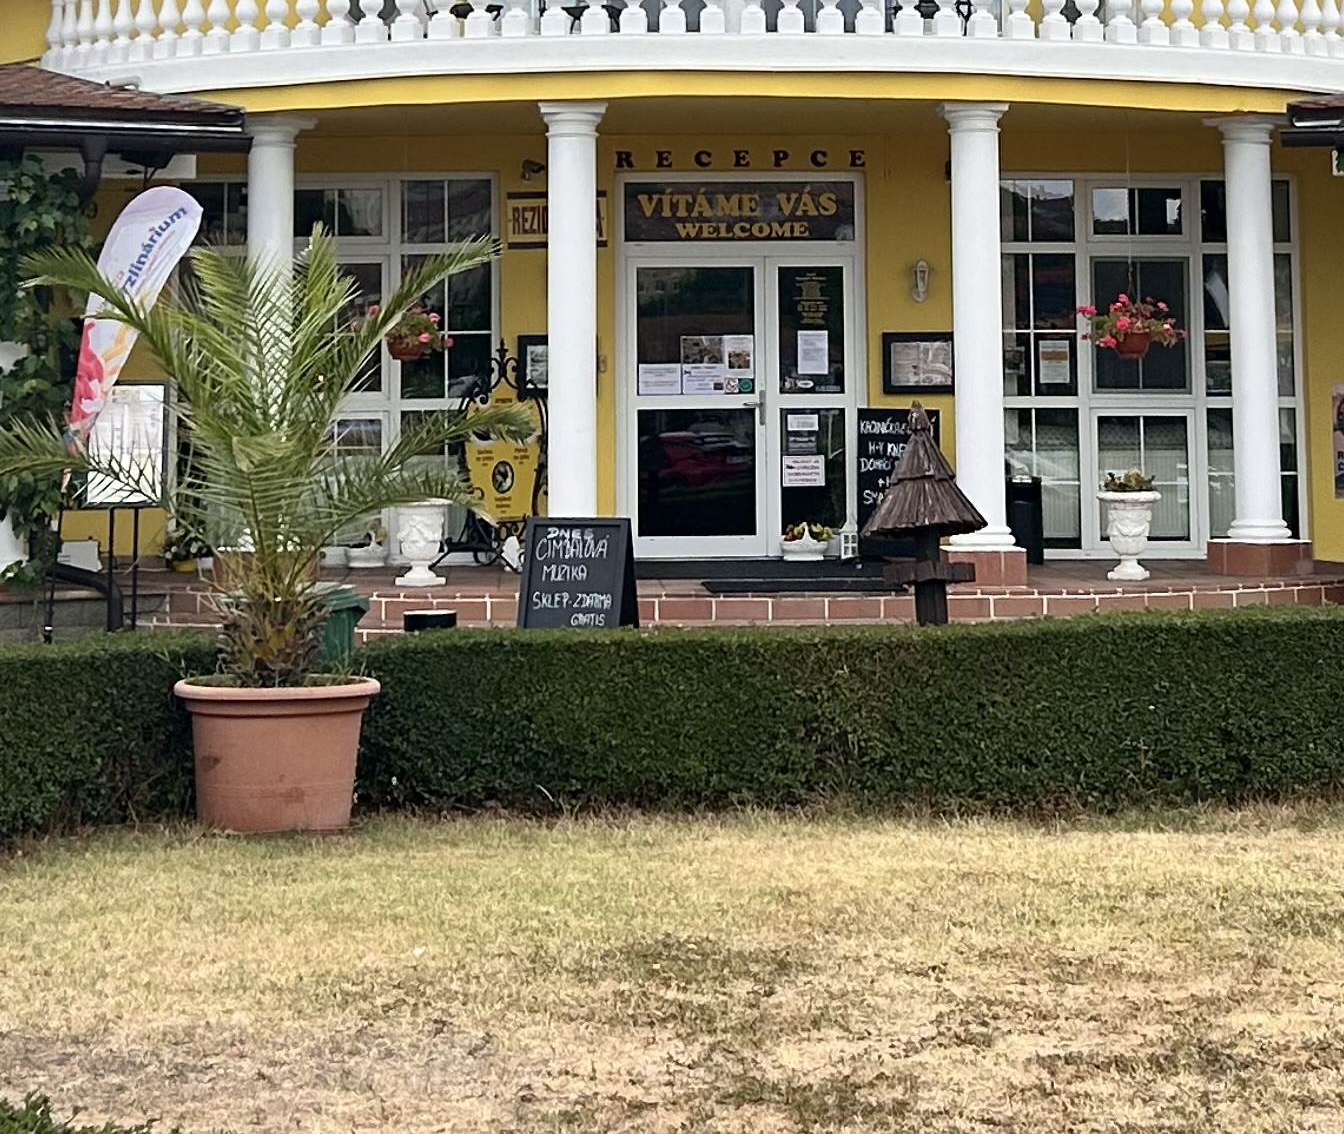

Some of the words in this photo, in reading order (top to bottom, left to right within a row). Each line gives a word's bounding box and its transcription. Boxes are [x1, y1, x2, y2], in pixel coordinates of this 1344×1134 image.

[614, 149, 866, 167] RECEPCE
[637, 188, 759, 217] VÍTÁME
[776, 185, 837, 216] VÁS
[675, 222, 809, 238] WELCOME
